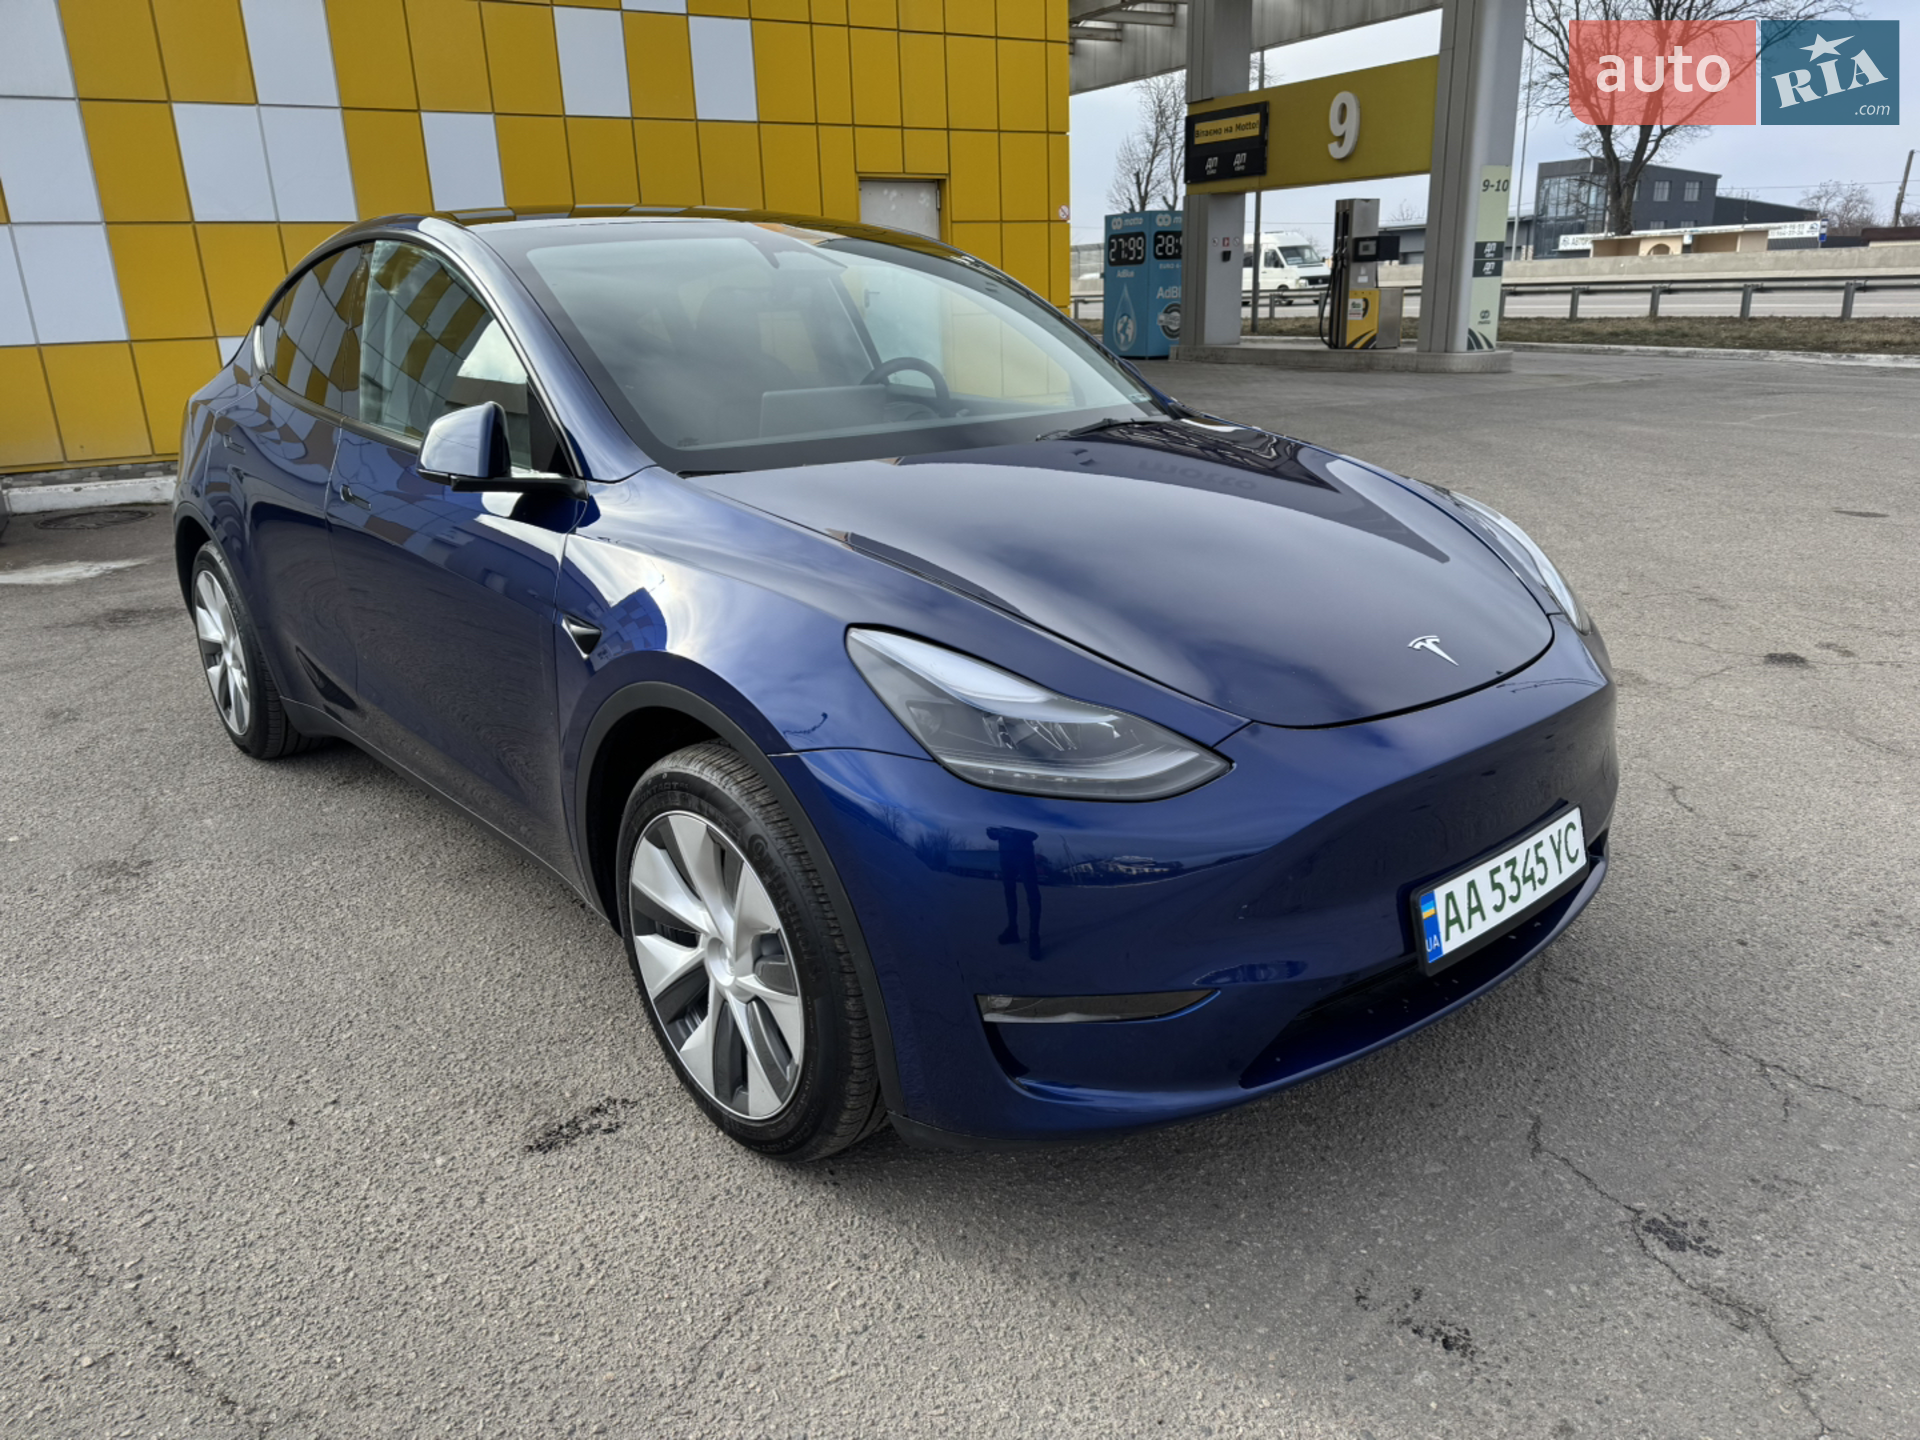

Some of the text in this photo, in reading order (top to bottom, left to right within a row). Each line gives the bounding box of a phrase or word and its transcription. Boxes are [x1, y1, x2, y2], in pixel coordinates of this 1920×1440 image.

[1224, 126, 1233, 134] на
[1327, 90, 1361, 160] 9
[1205, 157, 1218, 170] ДП
[1233, 153, 1246, 166] ДП
[1481, 178, 1509, 193] 9-10
[1156, 286, 1182, 299] AdBl
[1444, 821, 1579, 942] AA 5345 YC
[1425, 934, 1441, 953] UA
